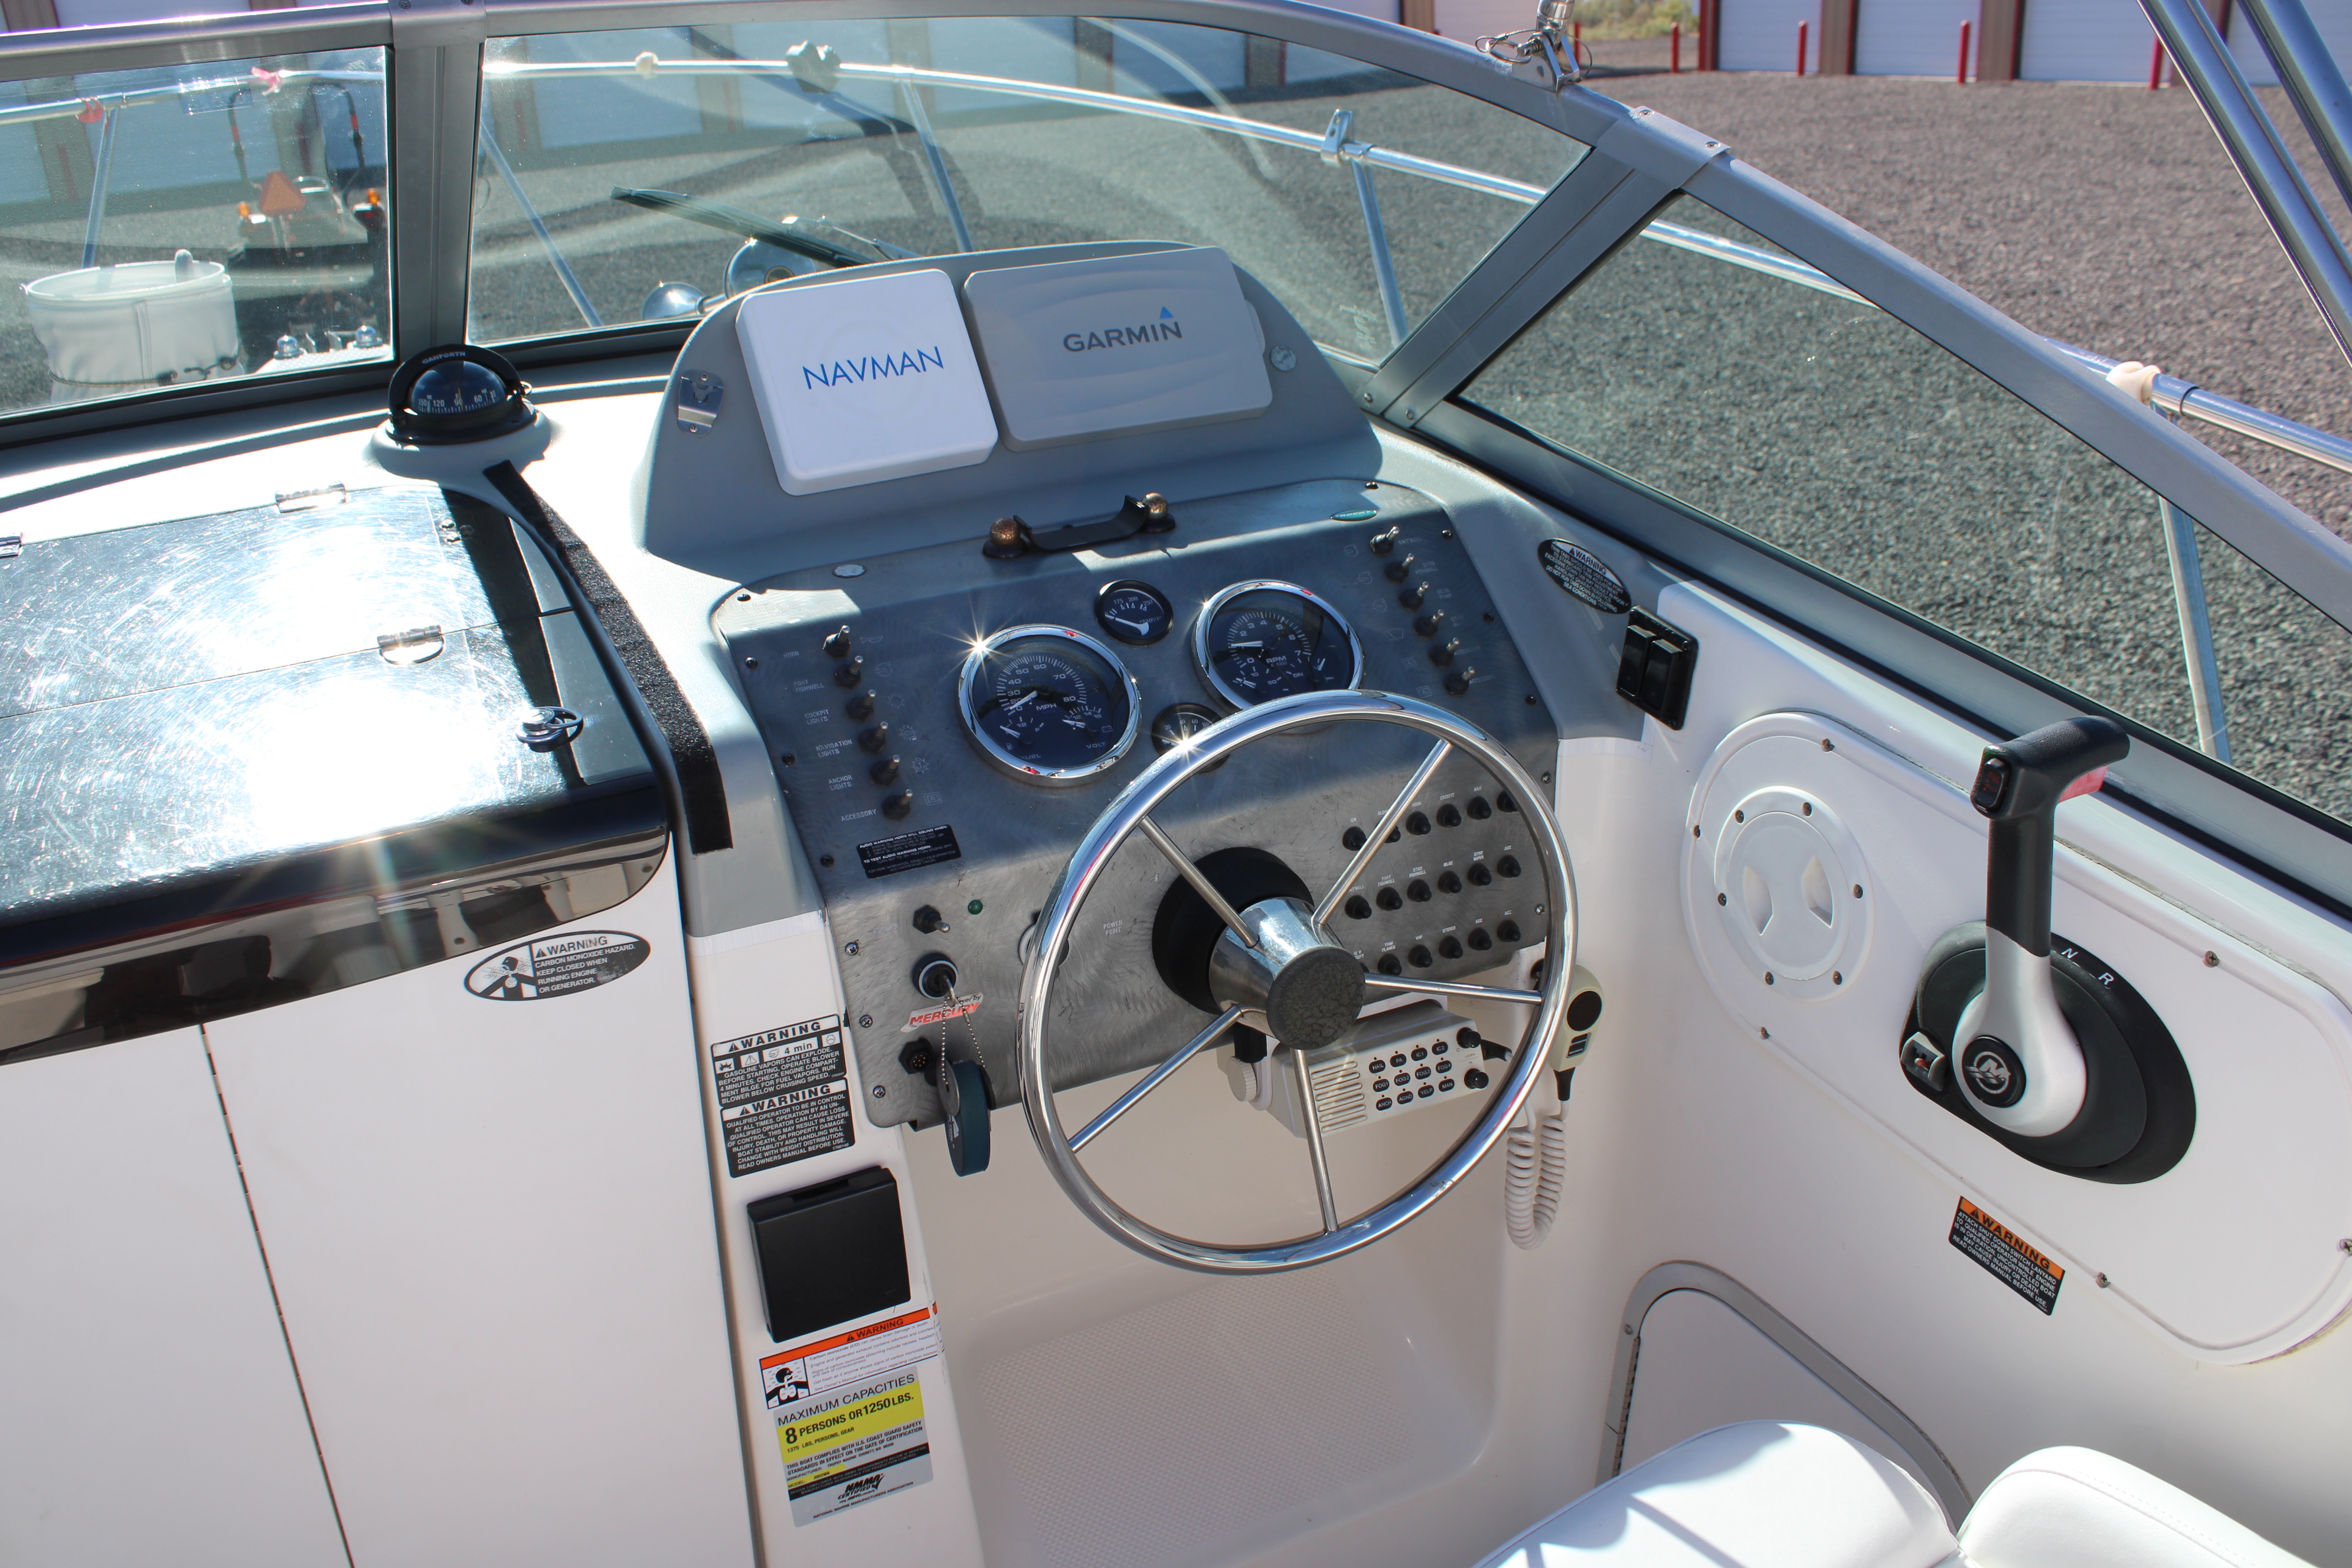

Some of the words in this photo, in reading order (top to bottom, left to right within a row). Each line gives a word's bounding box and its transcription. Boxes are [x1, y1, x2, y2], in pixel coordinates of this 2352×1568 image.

[1063, 321, 1182, 352] GARMIN
[422, 351, 466, 364] DANFORTH
[802, 346, 944, 390] NAVMAN
[1574, 549, 1606, 576] WARNING
[795, 682, 825, 693] FISHWELL
[805, 709, 829, 718] COCKPIT
[807, 716, 828, 725] LIGHTS
[816, 739, 853, 752] NAVIGATION
[818, 749, 839, 757] LIGHTS
[828, 775, 852, 785] ANCHOR
[829, 781, 852, 791] LIGHTS
[841, 809, 877, 822] ACCESSORY
[1103, 920, 1122, 929] POWER
[1105, 927, 1121, 936] POINT
[534, 957, 566, 968] CARBON
[566, 949, 604, 962] MONOXIDE
[605, 943, 635, 955] HAZARD.
[547, 935, 608, 956] WARNING
[2061, 948, 2078, 959] N
[536, 968, 556, 977] KEEP
[556, 962, 586, 973] CLOSED
[586, 957, 607, 966] WHEN
[537, 973, 570, 985] RUNNING
[570, 968, 597, 978] ENGINE
[2098, 972, 2114, 985] R
[551, 976, 596, 991] GENERATOR.
[910, 1002, 980, 1026] MERCURY
[740, 1021, 821, 1049] WARNING
[793, 1041, 812, 1052] min
[718, 1074, 745, 1086] BEFORE
[746, 1066, 780, 1079] STARTING,
[780, 1058, 811, 1070] OPERATE
[812, 1051, 839, 1062] BLOWER
[724, 1065, 757, 1079] GASOLINE
[758, 1058, 785, 1070] VAPORS
[785, 1054, 800, 1063] CAN
[801, 1046, 832, 1059] EXPLODE.
[725, 1077, 756, 1090] MINUTES.
[757, 1072, 779, 1082] CHECK
[780, 1066, 804, 1076] ENGINE
[805, 1057, 838, 1070] COMPART-
[721, 1088, 739, 1098] MENT
[740, 1083, 760, 1093] BILGE
[761, 1079, 774, 1087] FOR
[776, 1074, 792, 1084] FUEL
[793, 1067, 821, 1079] VAPORS.
[822, 1064, 835, 1072] RUN
[721, 1092, 750, 1104] BLOWER
[751, 1086, 774, 1096] BELOW
[775, 1077, 806, 1090] CRUISING
[807, 1071, 830, 1082] SPEED.
[752, 1084, 831, 1112] WARNING
[726, 1115, 757, 1128] QUALIFIED
[758, 1107, 790, 1120] OPERATOR
[817, 1093, 845, 1105] CONTROL
[743, 1122, 754, 1131] ALL
[756, 1118, 775, 1127] TIMES.
[776, 1109, 809, 1122] OPERATION
[1958, 1211, 1978, 1229] ATTACH
[1978, 1225, 1992, 1239] SHUT
[1992, 1236, 2010, 1252] DOWN
[2010, 1248, 2030, 1266] SWITCH
[2030, 1263, 2056, 1285] LANYARD
[1981, 1214, 2051, 1270] WARNING
[1956, 1217, 1963, 1225] TO
[1964, 1223, 1990, 1244] QUALIFIED
[1990, 1241, 2017, 1265] OPERATOR
[2017, 1261, 2034, 1276] WHILE
[2035, 1274, 2055, 1292] ENGINE
[1959, 1226, 1966, 1234] IN
[1965, 1230, 1996, 1256] OPERATION.
[1997, 1253, 2040, 1288] UNCONTROLLED
[2039, 1284, 2055, 1299] BOAT
[1963, 1235, 1974, 1247] MAY
[1974, 1243, 1992, 1260] CAUSE
[1992, 1257, 2011, 1274] INJURY
[2011, 1270, 2020, 1280] OR
[2020, 1277, 2040, 1295] DEATH.
[1952, 1234, 1967, 1249] READ
[1967, 1245, 1990, 1265] OWNERS
[1990, 1262, 2013, 1282] MANUAL
[2013, 1279, 2034, 1298] BEFORE
[2034, 1295, 2048, 1308] USE.
[856, 1318, 904, 1338] WARNING
[778, 1398, 839, 1426] MAXIMUM
[842, 1373, 914, 1405] CAPACITIES
[784, 1426, 798, 1445] 8
[798, 1413, 846, 1436] PERSONS
[848, 1408, 863, 1420] OR
[863, 1397, 891, 1415] 1250
[891, 1391, 914, 1406] LBS.
[786, 1445, 799, 1453] 1375
[801, 1440, 814, 1448] LBS,
[814, 1431, 839, 1444] PERSONS,
[840, 1426, 854, 1435] GEAR
[837, 1485, 871, 1500] CERTIFIED
